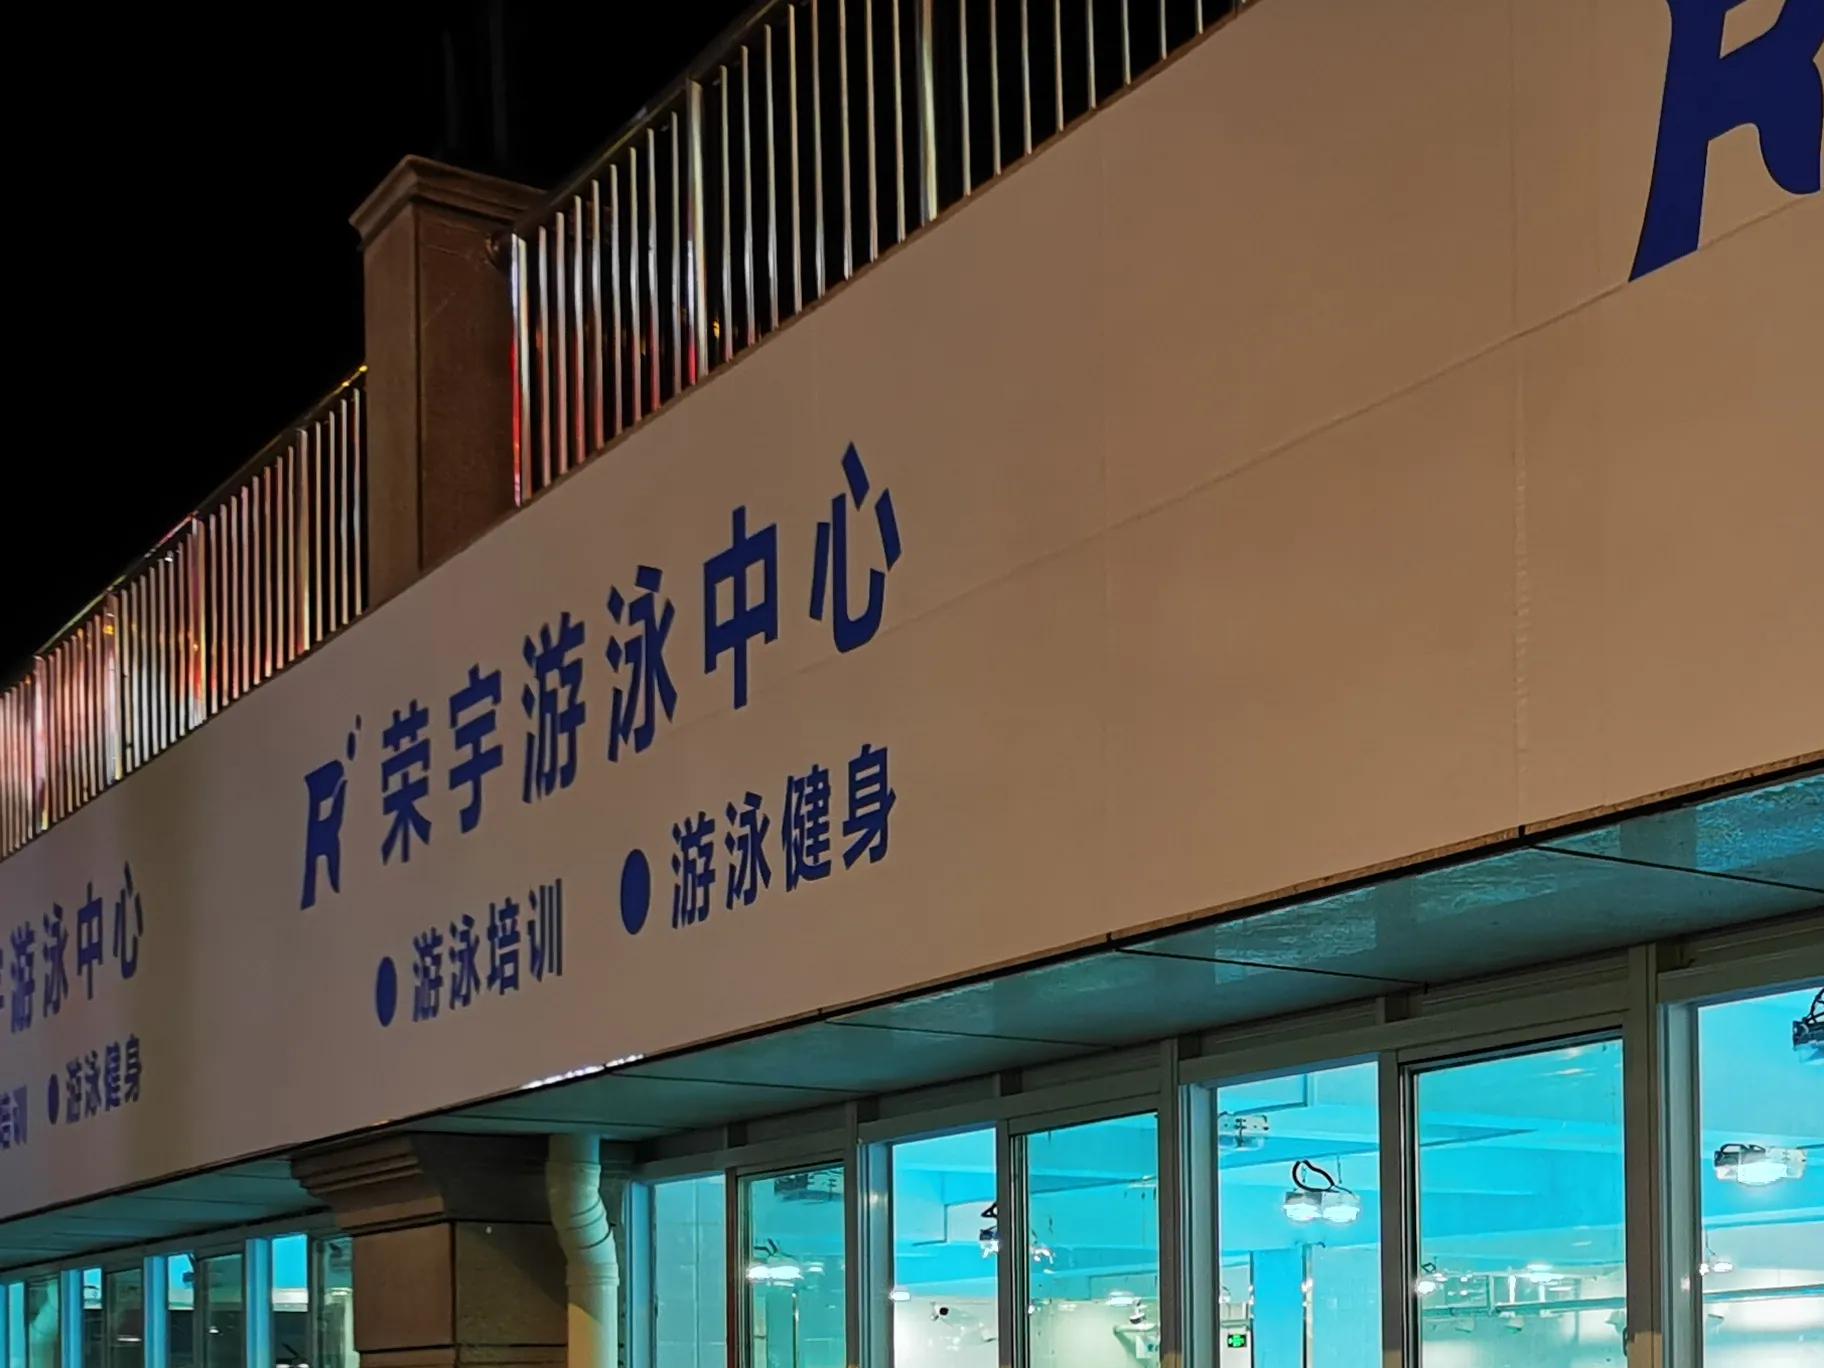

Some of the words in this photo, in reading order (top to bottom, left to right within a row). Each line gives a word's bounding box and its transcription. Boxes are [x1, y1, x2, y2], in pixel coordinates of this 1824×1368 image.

[381, 441, 902, 865] 荣宇游泳中心
[671, 743, 896, 929] 游泳健身
[0, 860, 143, 1035] 游泳中心
[412, 878, 563, 1022] 游泳培训
